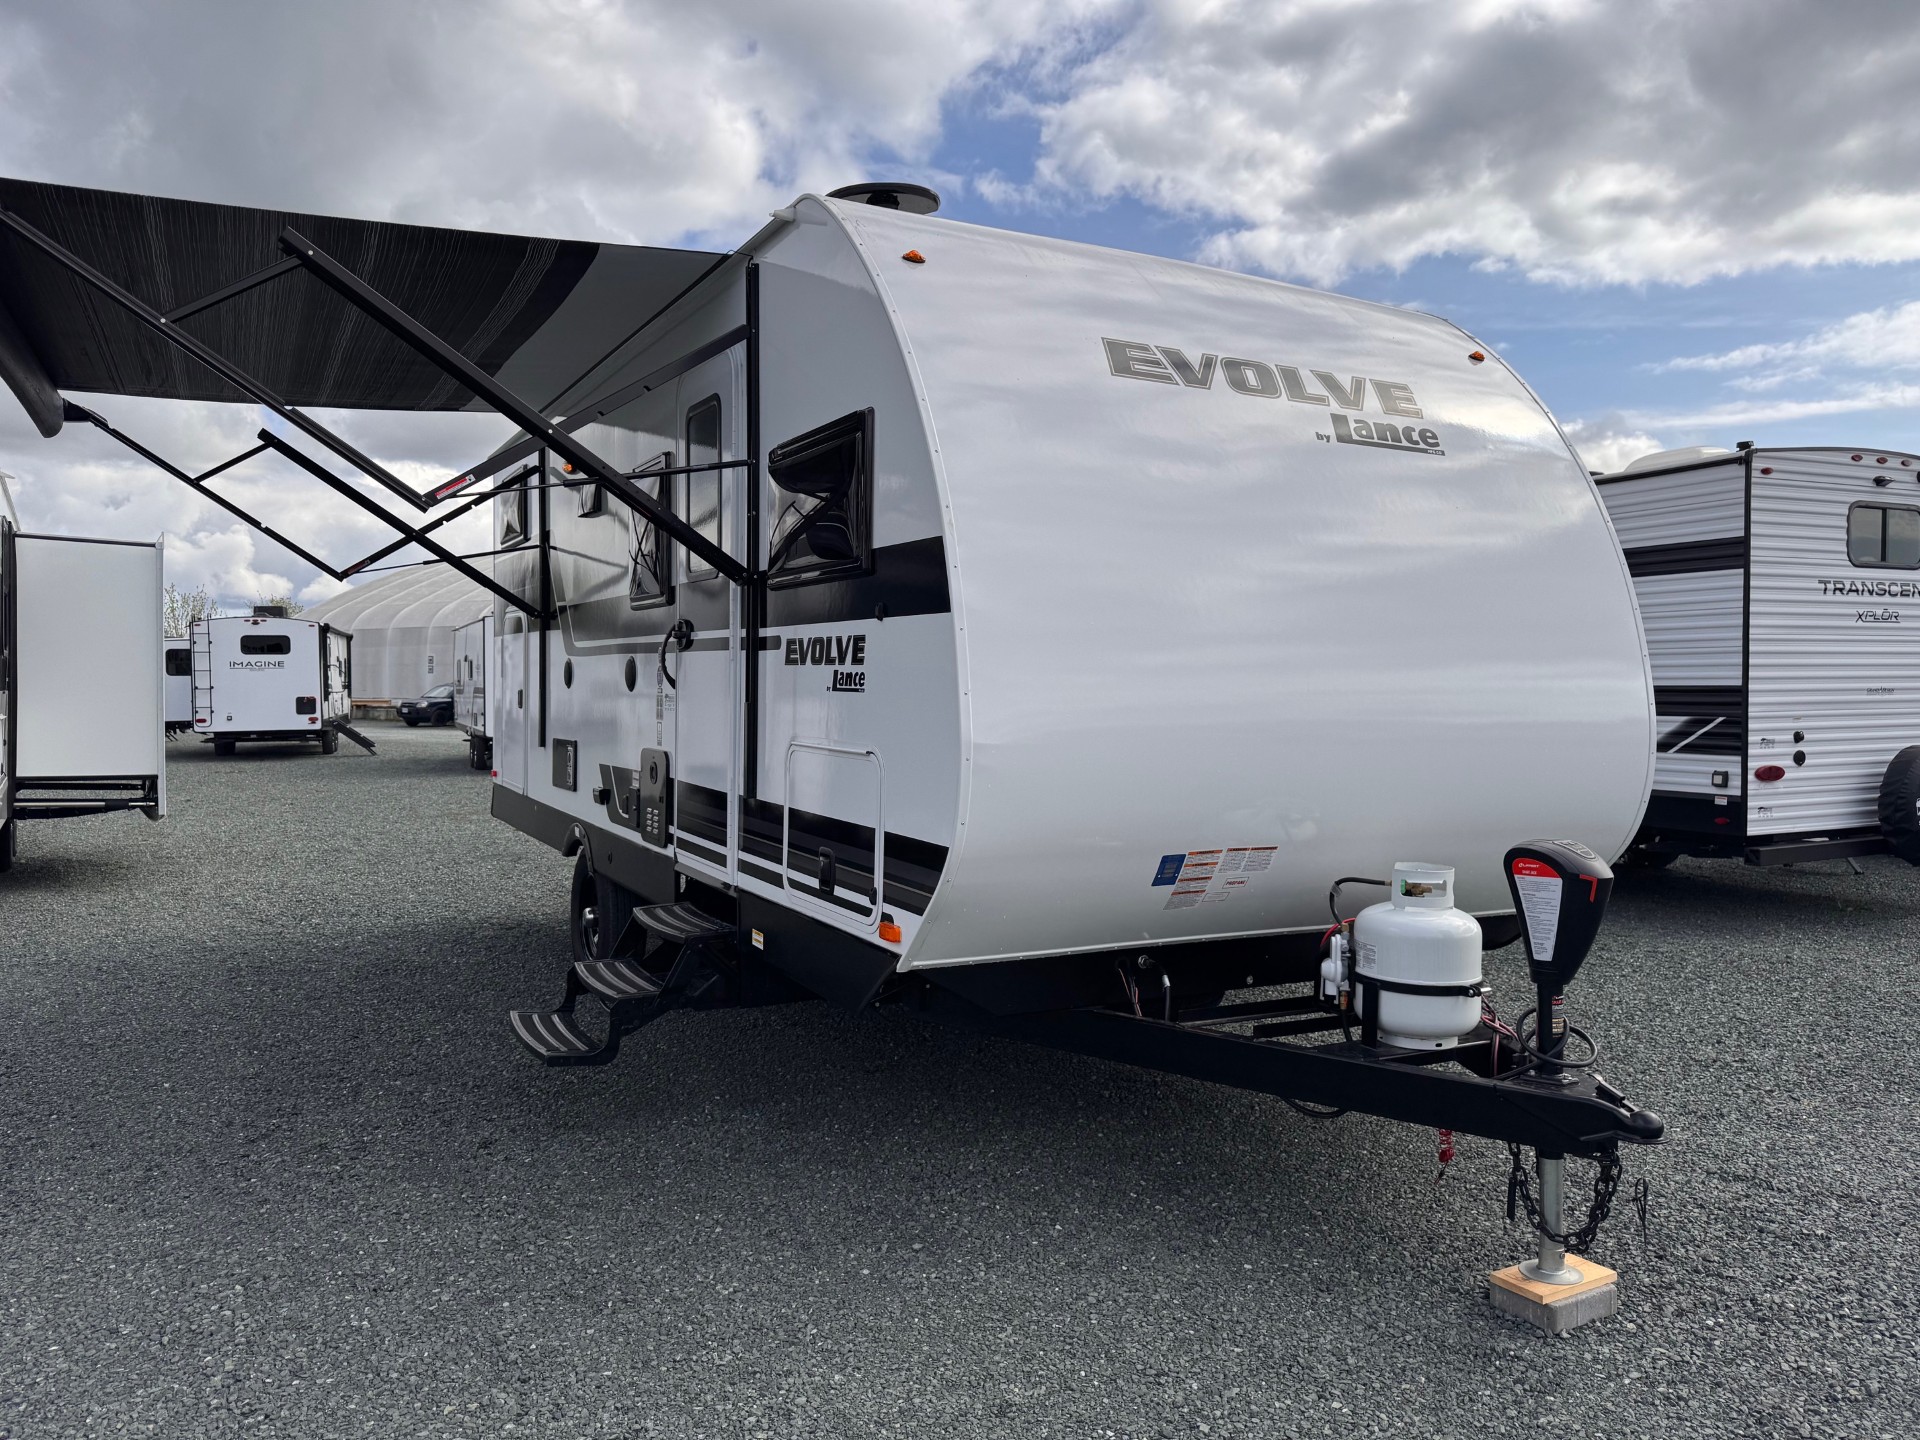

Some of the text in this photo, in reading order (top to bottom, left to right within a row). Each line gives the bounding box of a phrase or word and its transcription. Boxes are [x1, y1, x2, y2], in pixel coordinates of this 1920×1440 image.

[1100, 337, 1424, 419] EVOLVE
[1315, 413, 1446, 456] by Lance
[785, 634, 866, 665] EVOLVE
[831, 669, 866, 693] Lance
